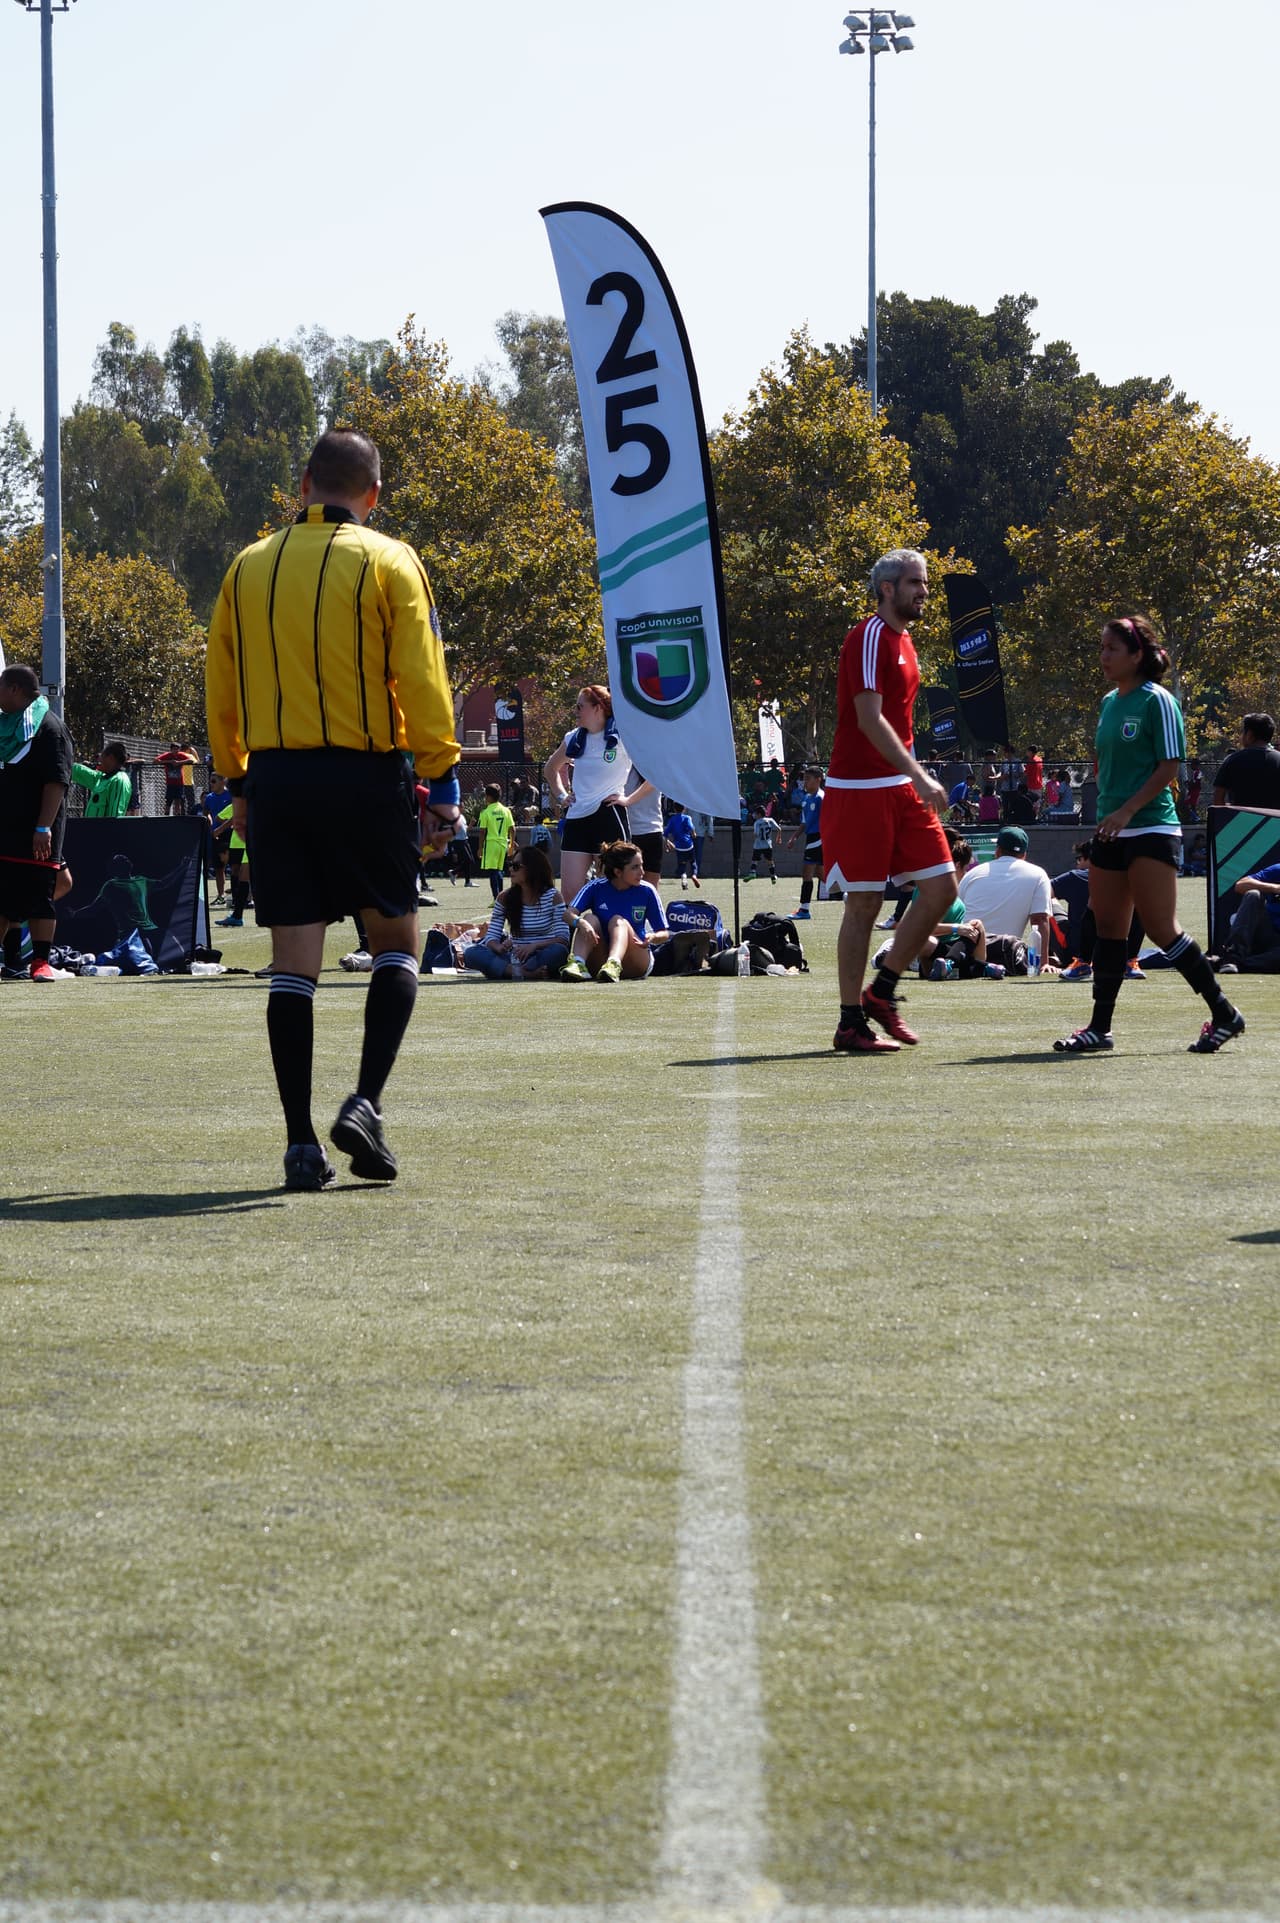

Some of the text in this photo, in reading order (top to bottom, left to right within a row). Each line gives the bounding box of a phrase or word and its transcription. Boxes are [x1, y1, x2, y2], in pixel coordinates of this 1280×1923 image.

[586, 271, 670, 496] 25
[620, 615, 700, 633] copa univision
[496, 817, 504, 836] 7
[760, 825, 771, 841] 12
[668, 912, 712, 928] adidas
